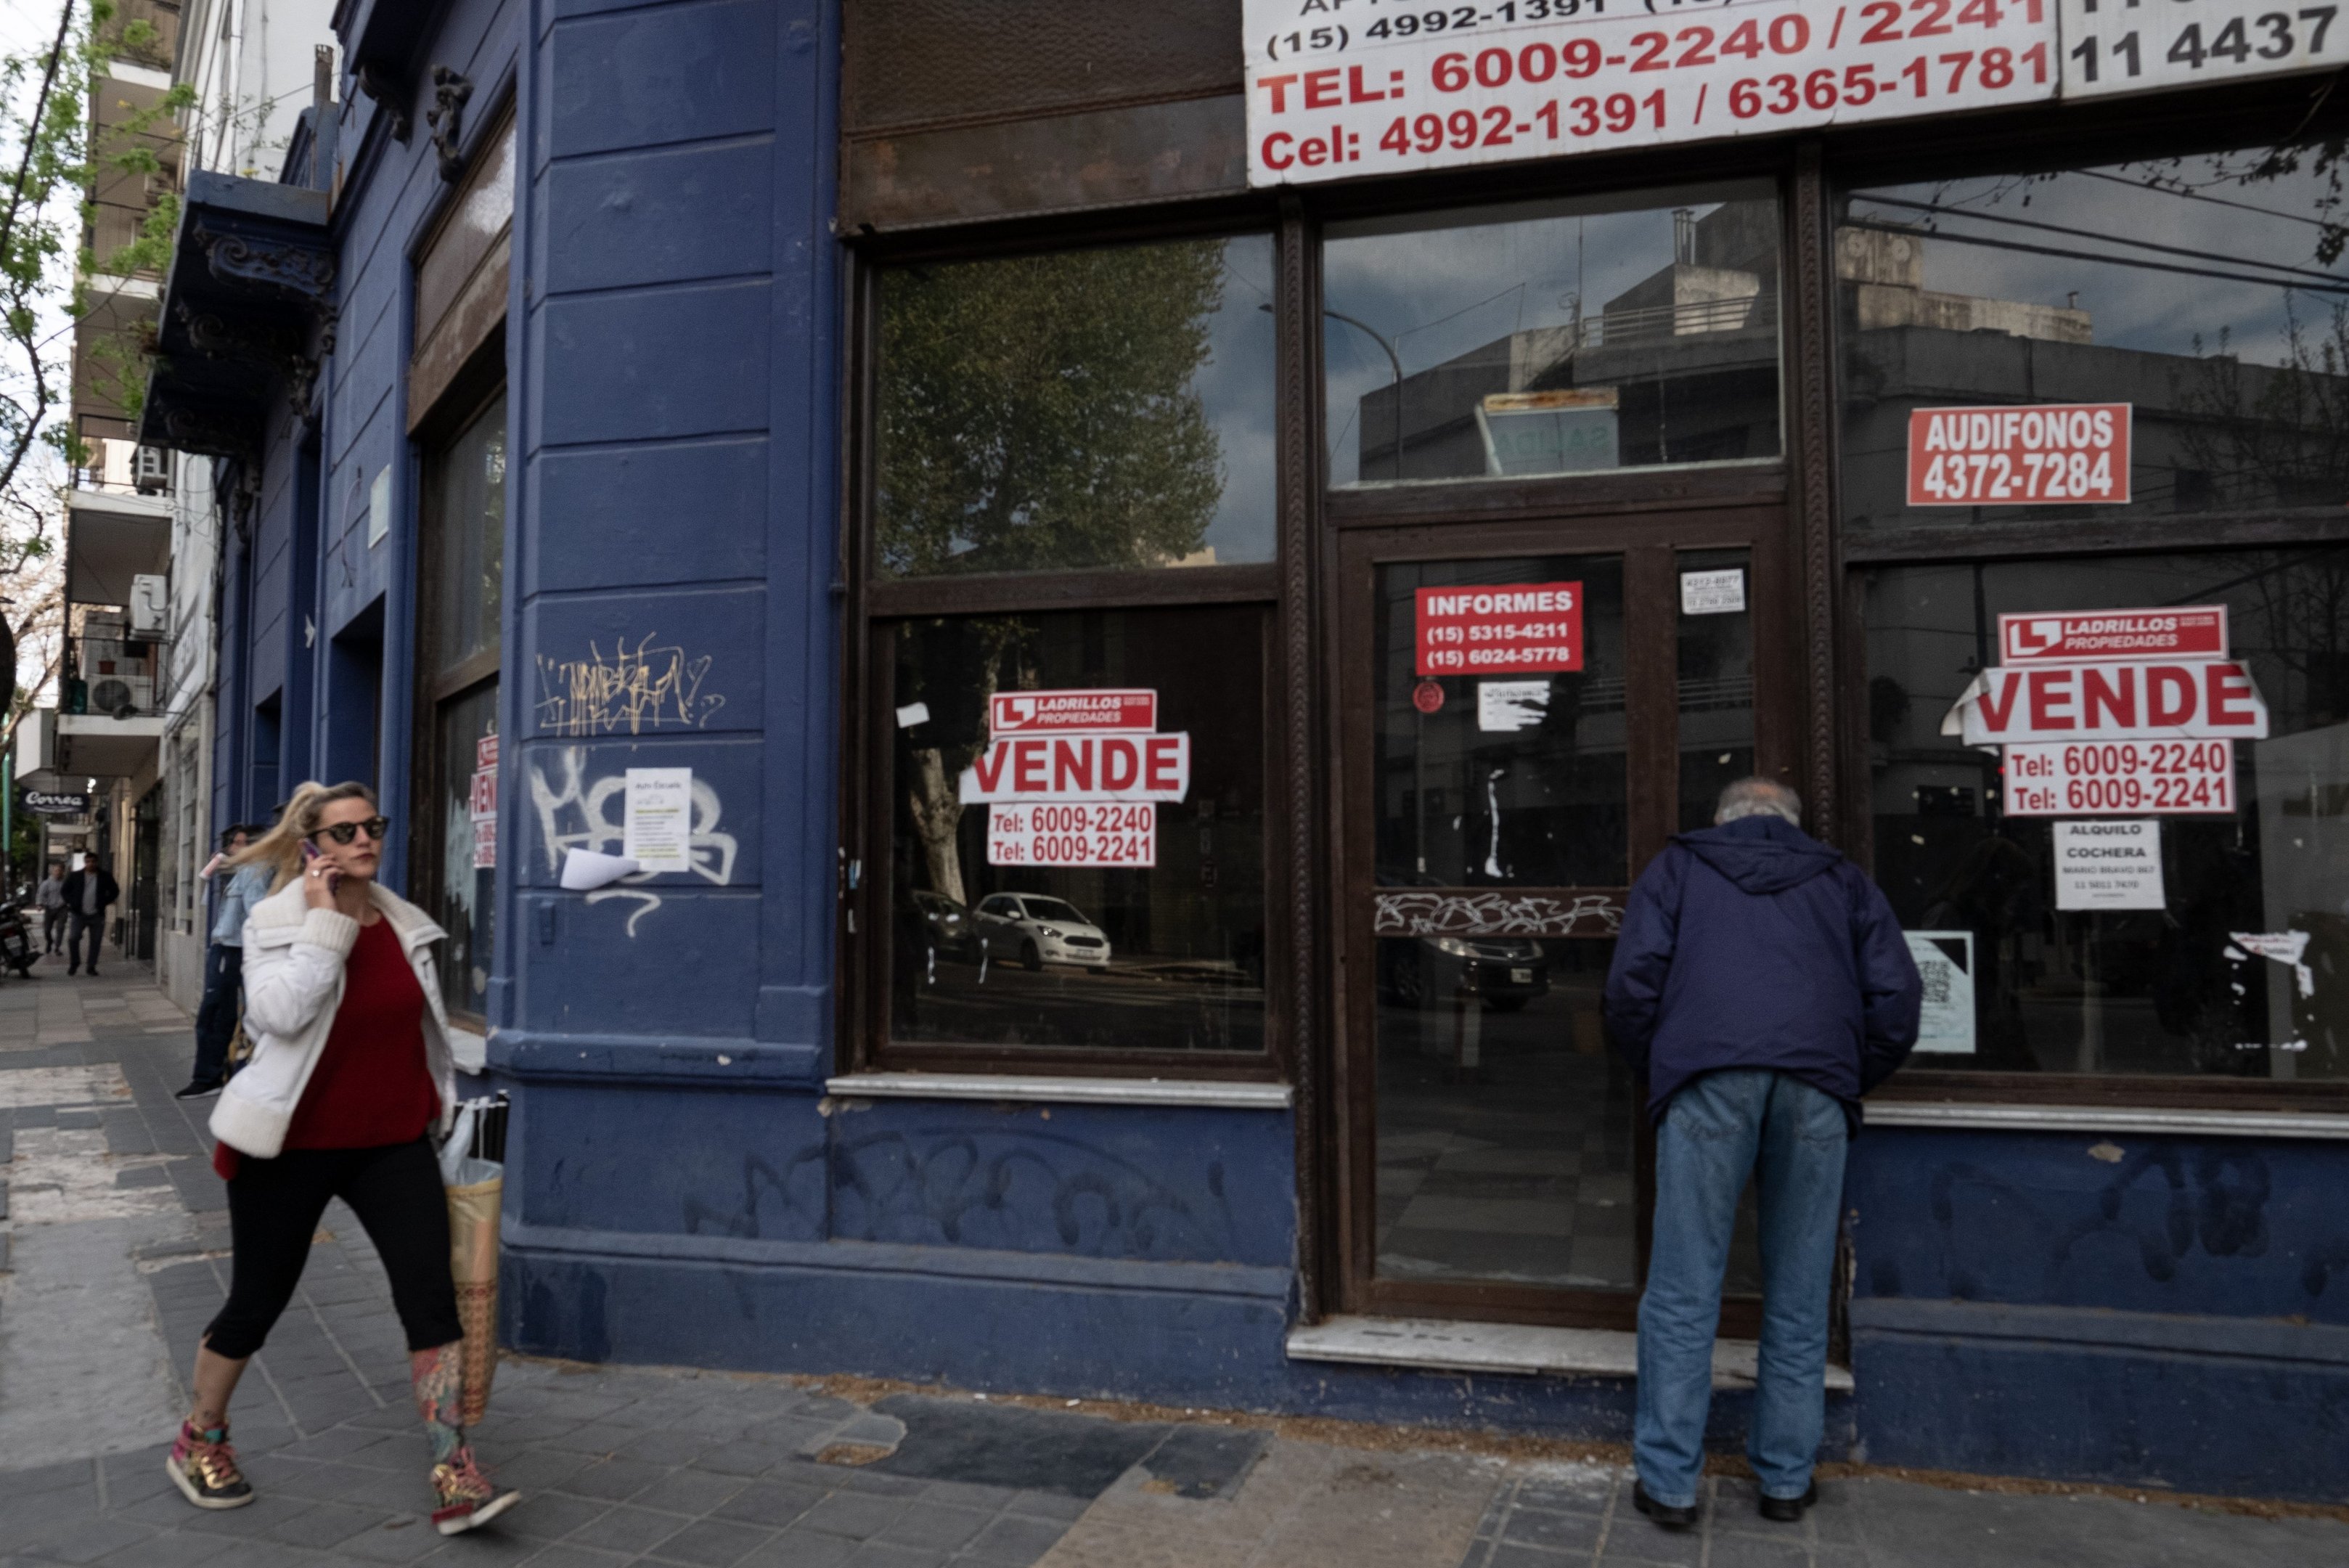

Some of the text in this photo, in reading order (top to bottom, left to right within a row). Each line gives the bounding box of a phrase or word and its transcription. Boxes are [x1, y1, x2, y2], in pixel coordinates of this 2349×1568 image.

[1266, 25, 1349, 62] (15)
[2072, 5, 2338, 83] 11 4437
[1257, 0, 2043, 114] TEL: 6009-2240 / 2241
[1262, 41, 2047, 171] Cel: 4992-1391 / 6365-1781
[1925, 409, 2113, 451] AUDIFONOS
[1923, 451, 2113, 499] 4372-7284
[1427, 591, 1573, 616] INFORMES
[1426, 622, 1568, 645] (15) 5315-4211
[2064, 617, 2178, 635] LADRILLOS
[2064, 634, 2178, 650] PROPIEDADES
[1426, 646, 1570, 669] (15) 6024-5778
[1037, 697, 1122, 711] LADRILLOS
[1977, 663, 2256, 733] VENDE
[1037, 710, 1122, 724] PROPIEDADES
[973, 738, 1180, 793] VENDE
[2011, 743, 2226, 777] Tel: 6009-2240
[25, 791, 84, 807] Correa
[2013, 777, 2226, 809] Tel: 6009-2241
[994, 806, 1152, 833] Tel: 6009-2240
[2070, 824, 2142, 836] ALQUILO
[994, 836, 1151, 862] Tel: 6009-2241
[2066, 847, 2146, 859] COCHERA
